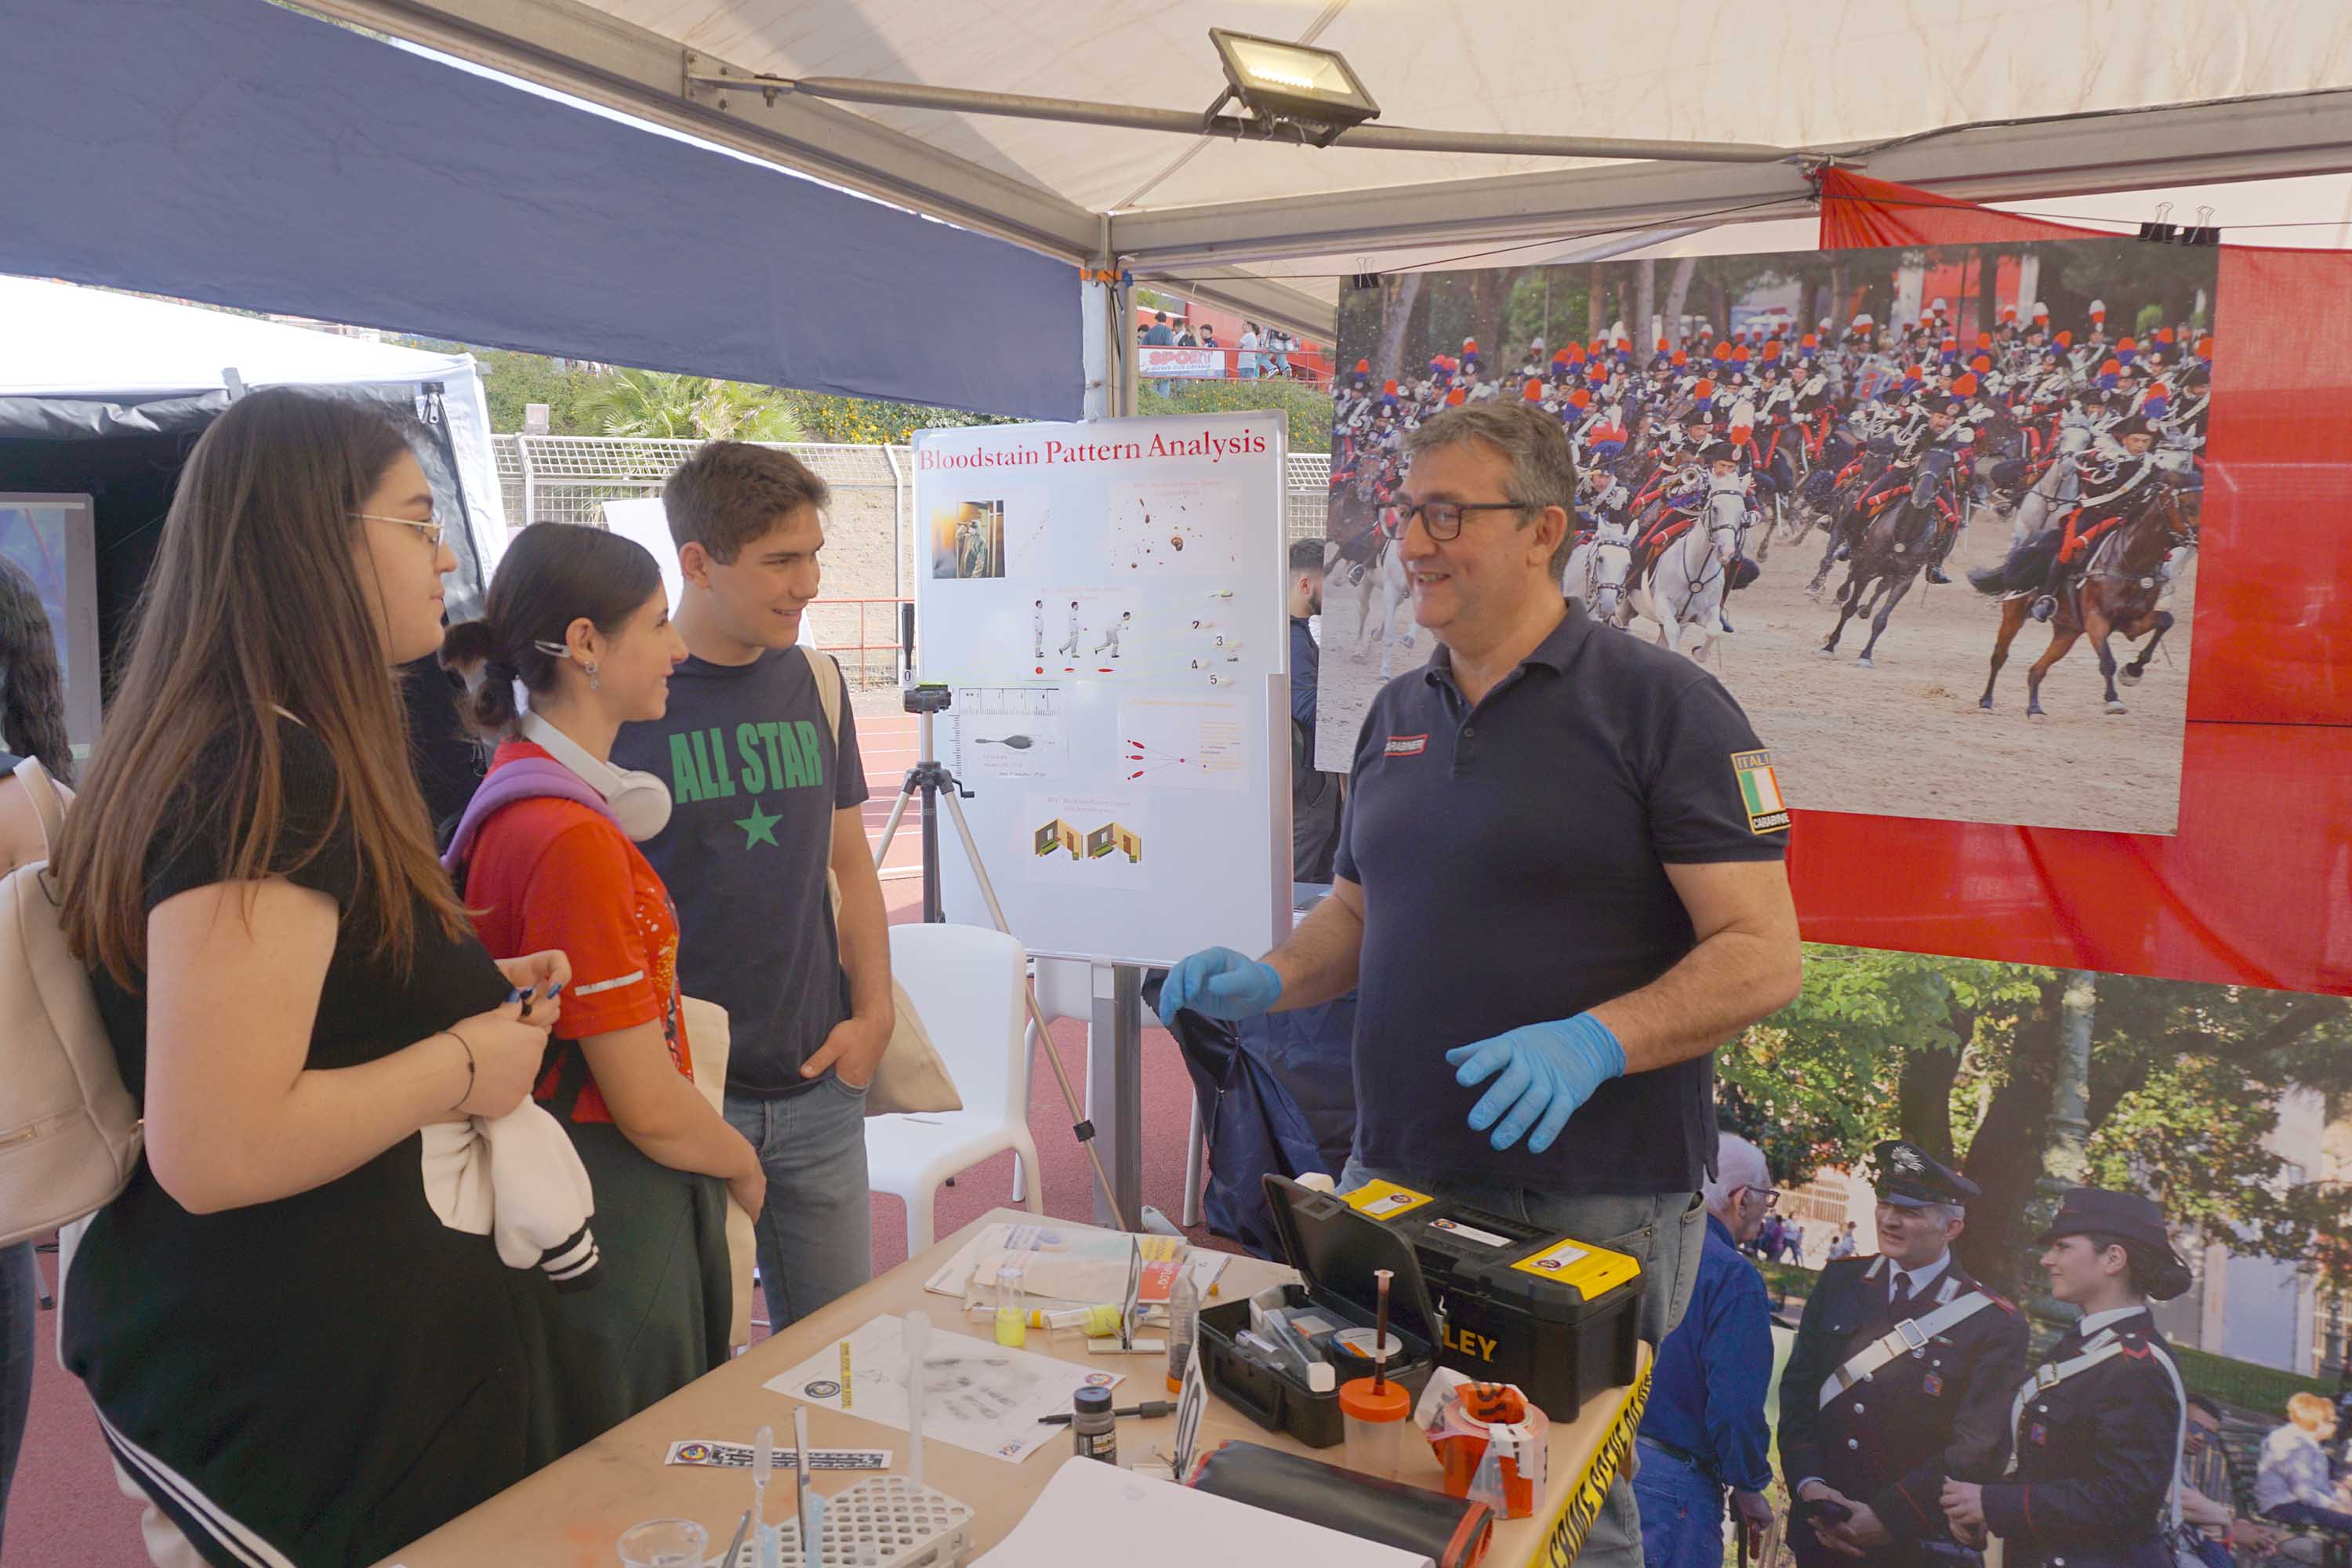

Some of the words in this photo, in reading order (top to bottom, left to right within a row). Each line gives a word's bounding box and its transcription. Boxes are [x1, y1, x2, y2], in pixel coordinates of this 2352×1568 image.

[1149, 350, 1211, 365] SPORT
[919, 445, 1039, 470] Bloodstain
[1045, 439, 1142, 463] Pattern
[1149, 428, 1267, 464] Analysis
[1216, 636, 1223, 647] 3
[1191, 659, 1199, 670] 4
[1210, 674, 1218, 684] 5
[669, 728, 736, 804] ALL
[735, 720, 823, 794] STAR
[1443, 1323, 1498, 1363] LEY
